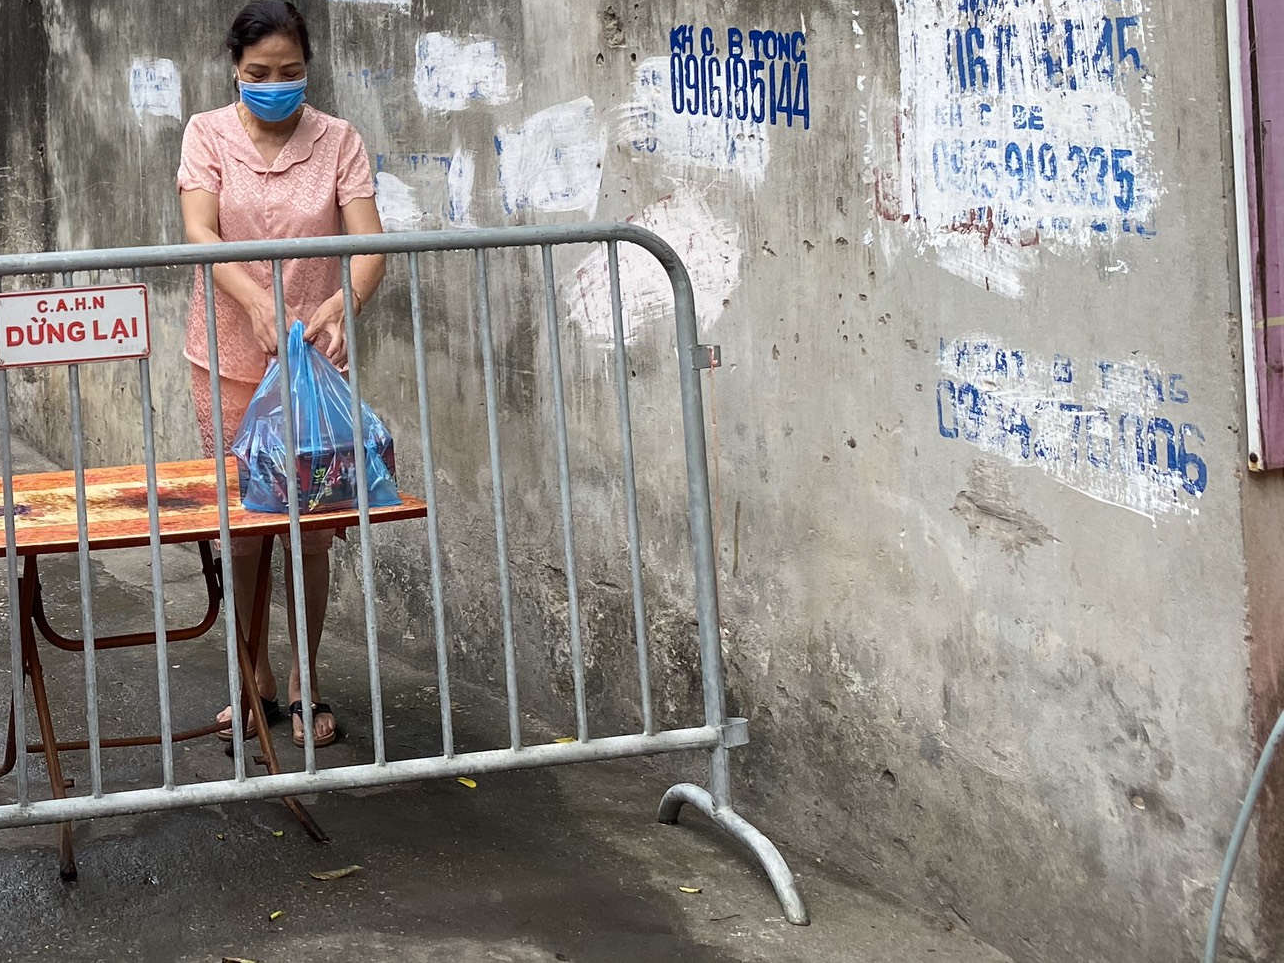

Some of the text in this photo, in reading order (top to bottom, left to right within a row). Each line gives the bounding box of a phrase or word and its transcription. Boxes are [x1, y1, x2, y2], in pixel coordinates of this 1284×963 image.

[37, 296, 105, 314] C.A.H.N
[6, 316, 138, 347] DỪNG LẠI
